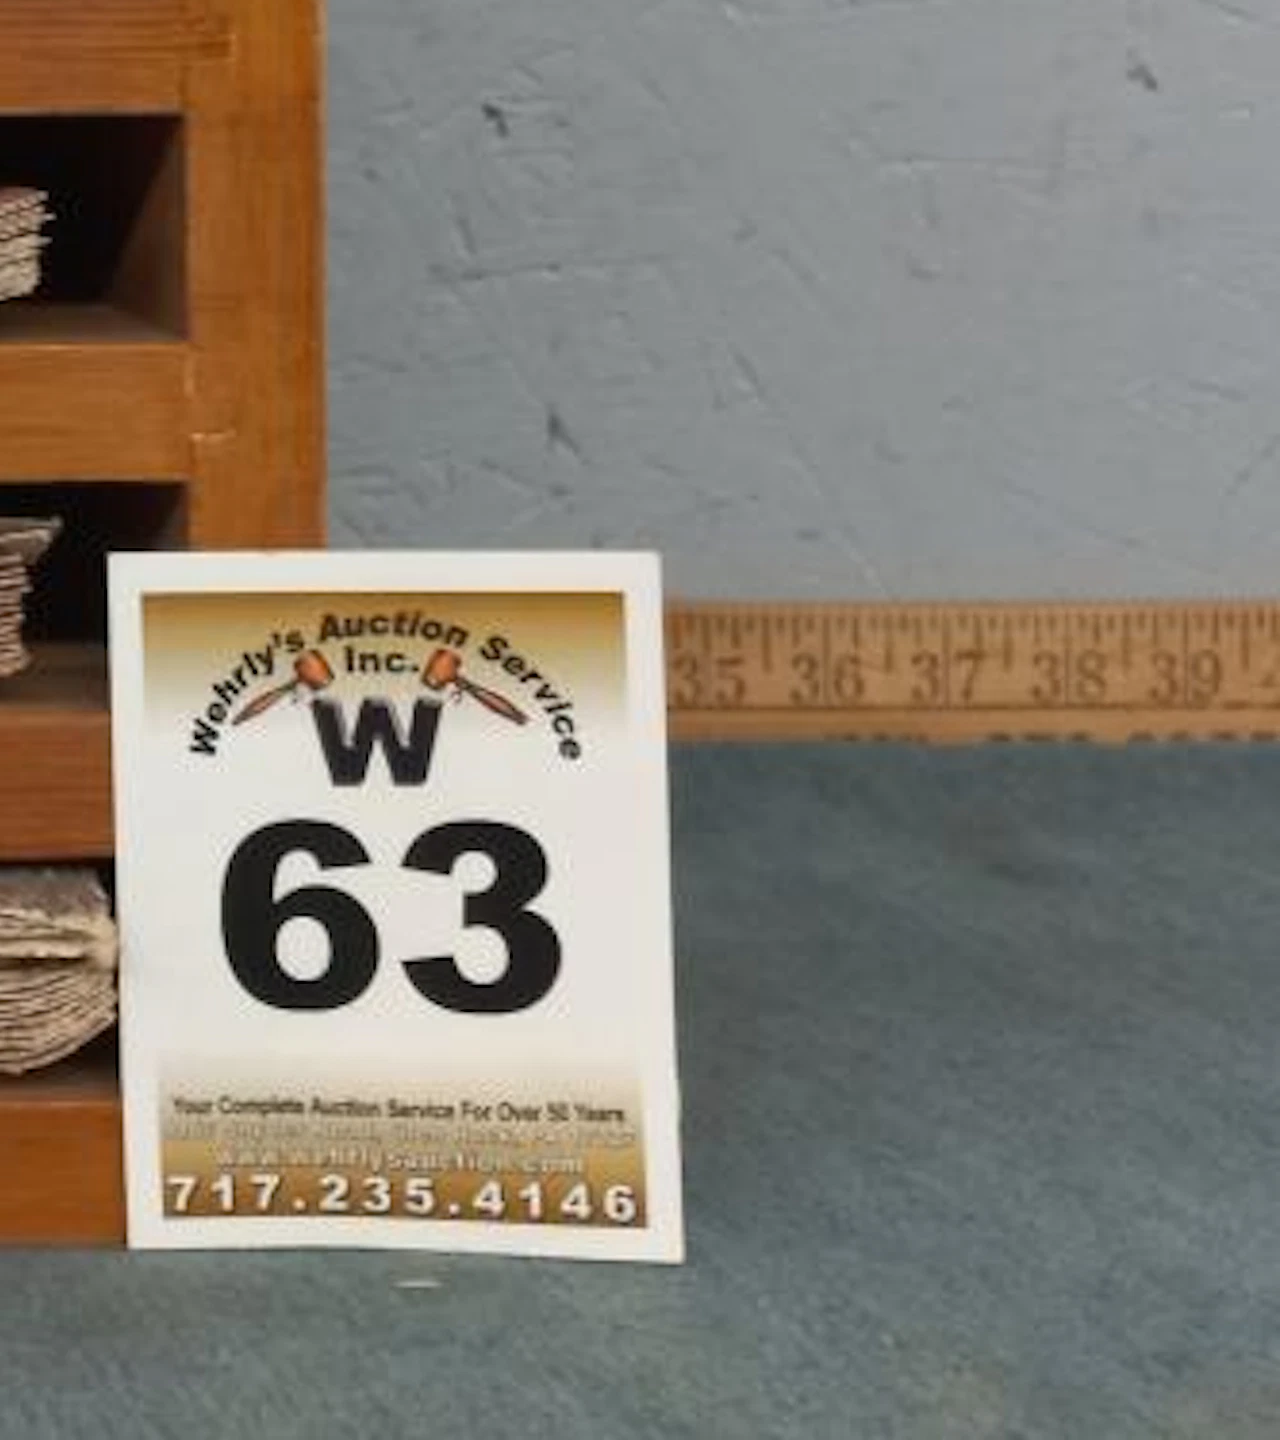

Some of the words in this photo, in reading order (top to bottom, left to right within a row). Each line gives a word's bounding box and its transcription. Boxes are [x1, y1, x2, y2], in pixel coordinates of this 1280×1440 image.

[189, 628, 306, 758] Wehrly's
[319, 612, 470, 649] Auction
[479, 634, 582, 762] Service
[344, 646, 420, 675] Inc.
[672, 654, 746, 707] 35
[789, 652, 866, 706] 36
[909, 649, 987, 704] 37
[1031, 648, 1109, 703] 38
[1147, 648, 1224, 709] 39
[310, 697, 443, 788] W
[220, 817, 563, 1015] 63
[216, 1095, 305, 1117] Complete
[310, 1096, 383, 1117] Auction
[387, 1098, 455, 1120] Service
[461, 1101, 492, 1122] For
[496, 1101, 540, 1124] Over
[166, 1171, 640, 1224] 717.235.4146
